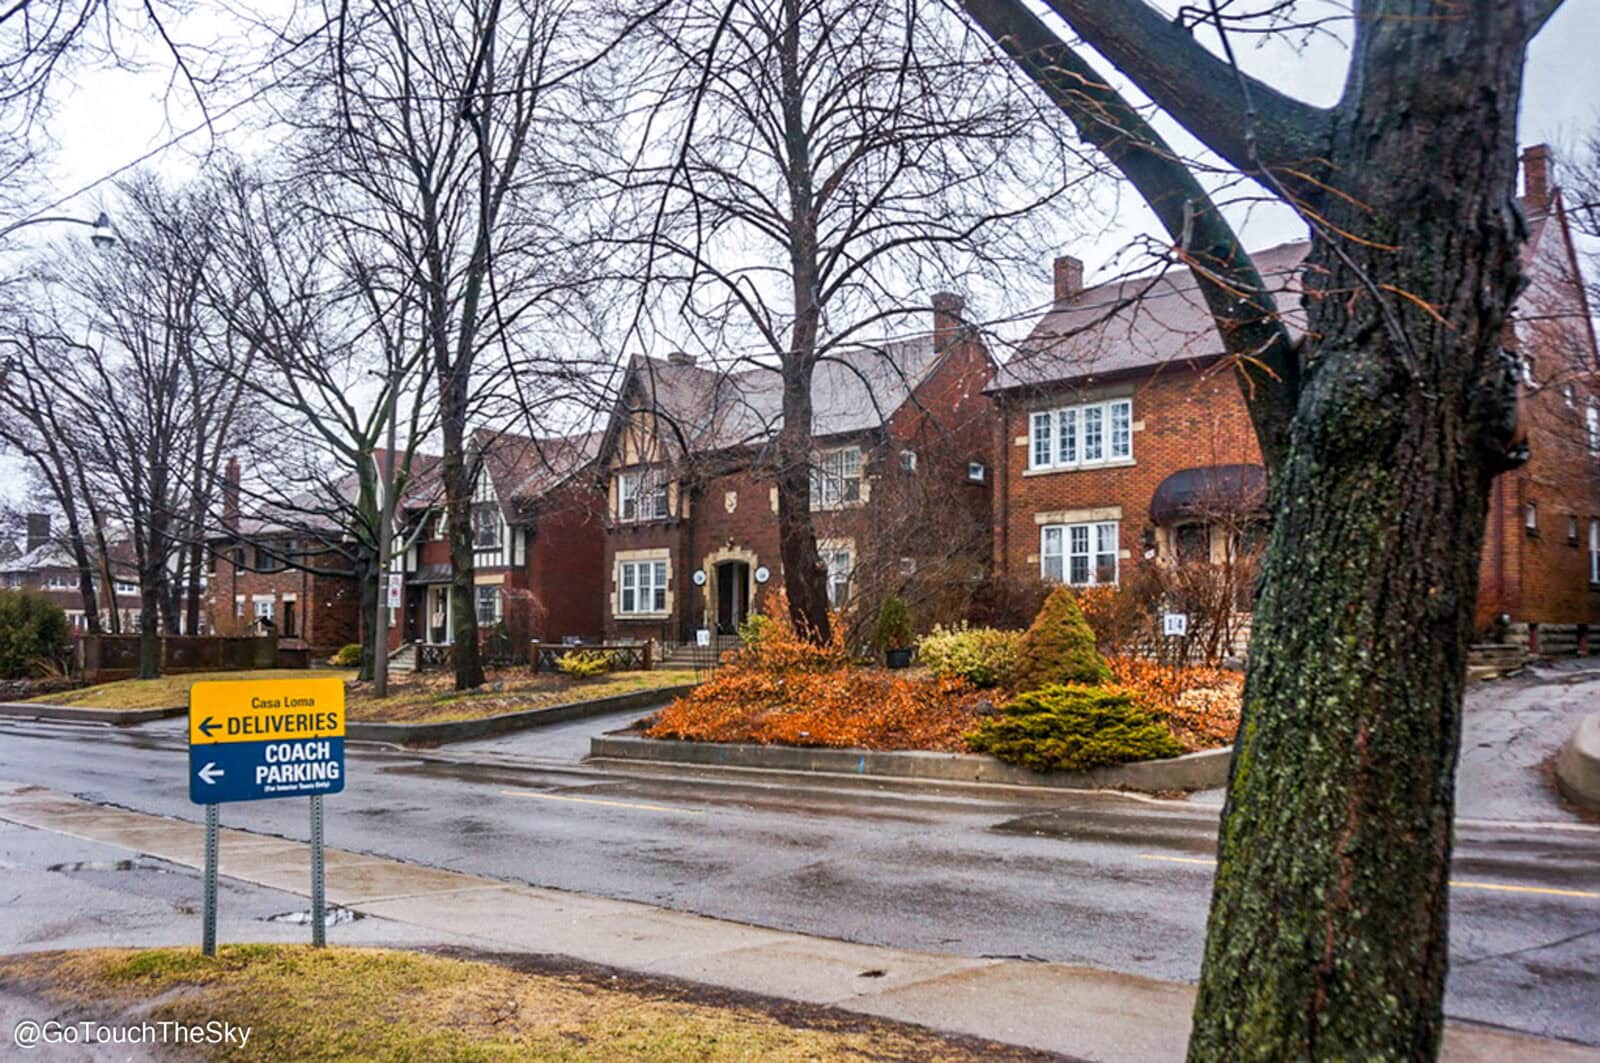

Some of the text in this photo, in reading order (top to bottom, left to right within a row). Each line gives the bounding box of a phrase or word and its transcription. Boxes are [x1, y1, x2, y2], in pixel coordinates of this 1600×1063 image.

[251, 696, 315, 709] Casa Loma
[227, 712, 338, 735] DELIVERIES
[265, 742, 330, 763] COACH
[255, 761, 340, 785] PARKING
